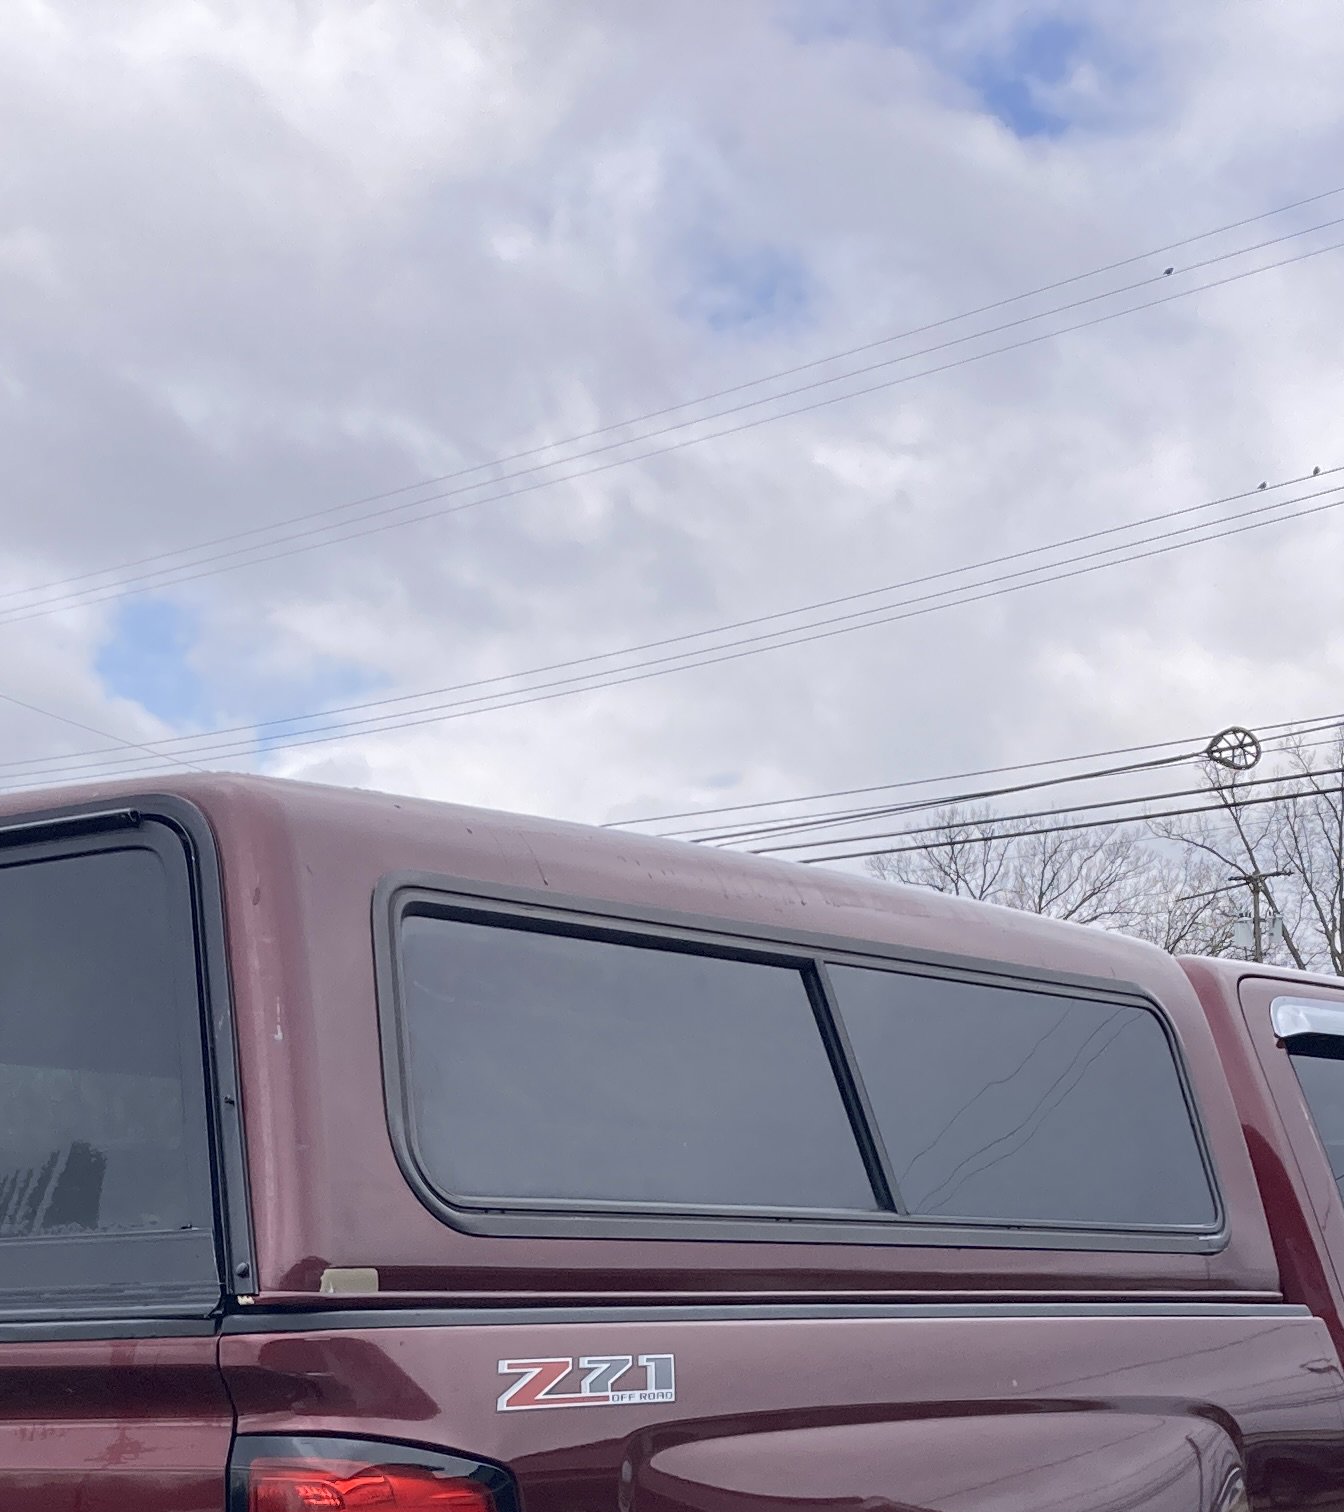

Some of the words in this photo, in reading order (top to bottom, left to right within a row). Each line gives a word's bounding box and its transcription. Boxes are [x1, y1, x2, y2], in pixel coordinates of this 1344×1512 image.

[495, 1353, 676, 1413] Z71
[611, 1393, 636, 1402] OFF
[639, 1391, 673, 1401] ROAD
